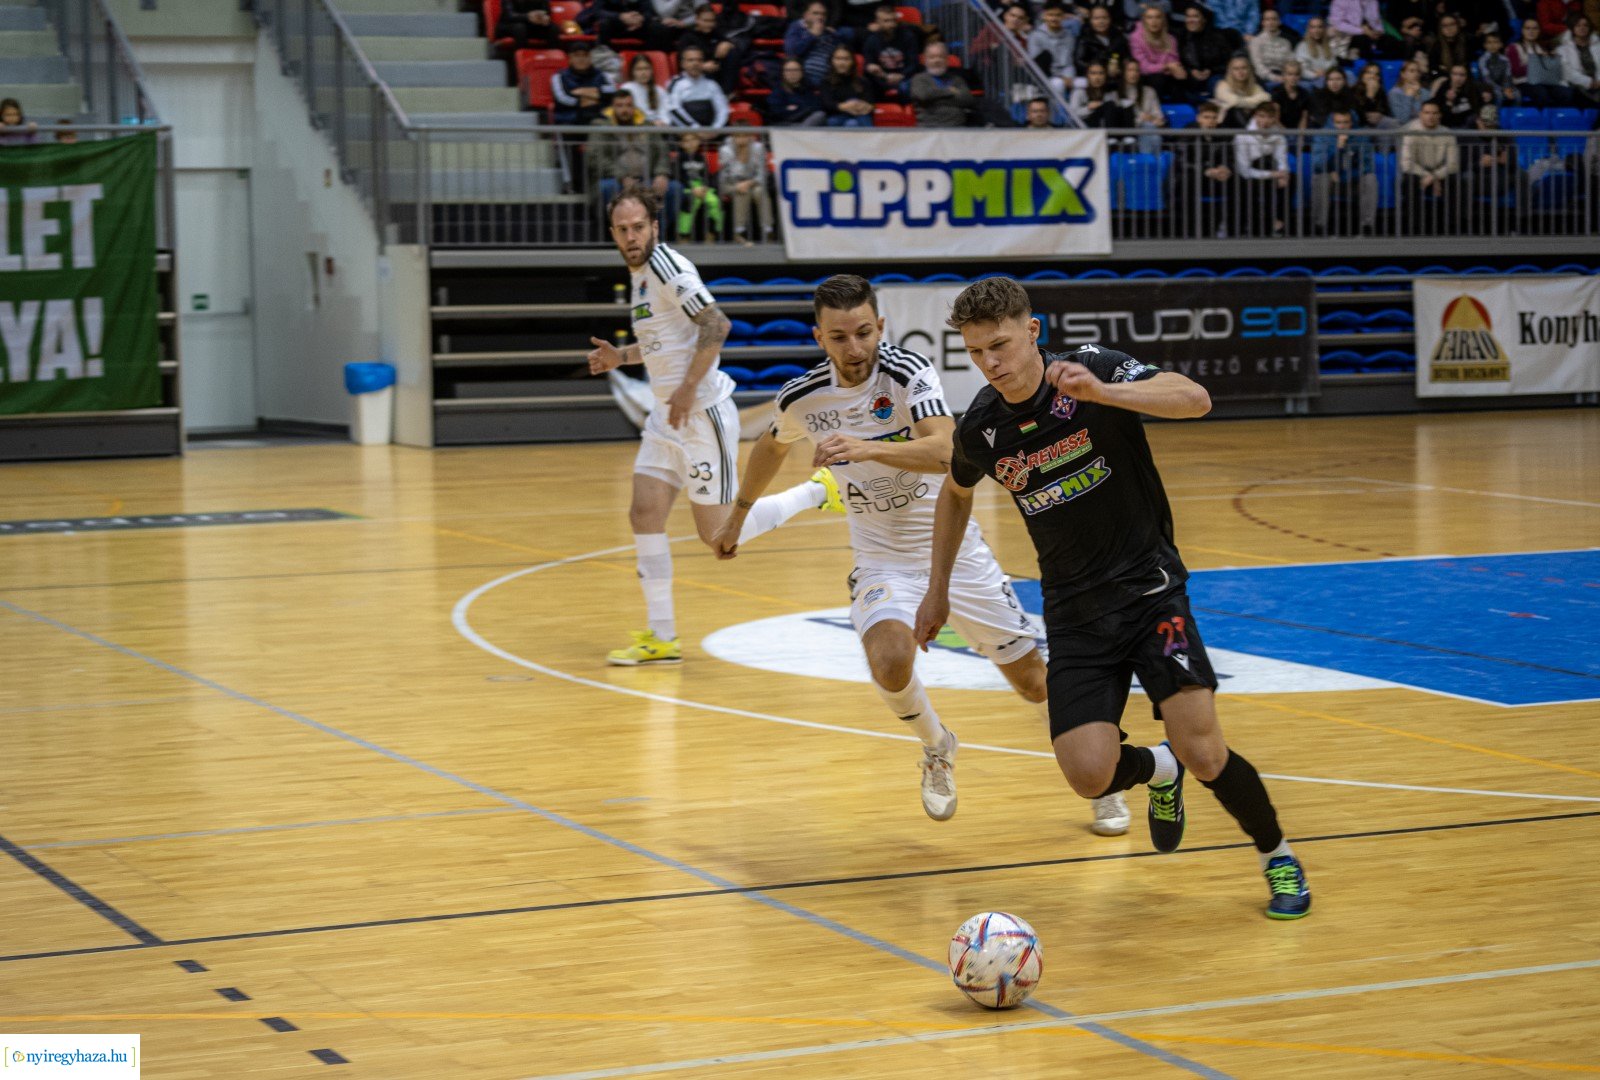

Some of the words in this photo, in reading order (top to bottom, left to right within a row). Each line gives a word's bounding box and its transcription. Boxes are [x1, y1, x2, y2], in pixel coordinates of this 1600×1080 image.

[1240, 305, 1307, 338] 90
[1518, 310, 1600, 348] Konyh
[0, 297, 104, 383] YA!
[1256, 356, 1301, 373] KFT
[805, 410, 842, 433] 383
[689, 462, 713, 481] 33
[850, 483, 929, 513] STUDIO
